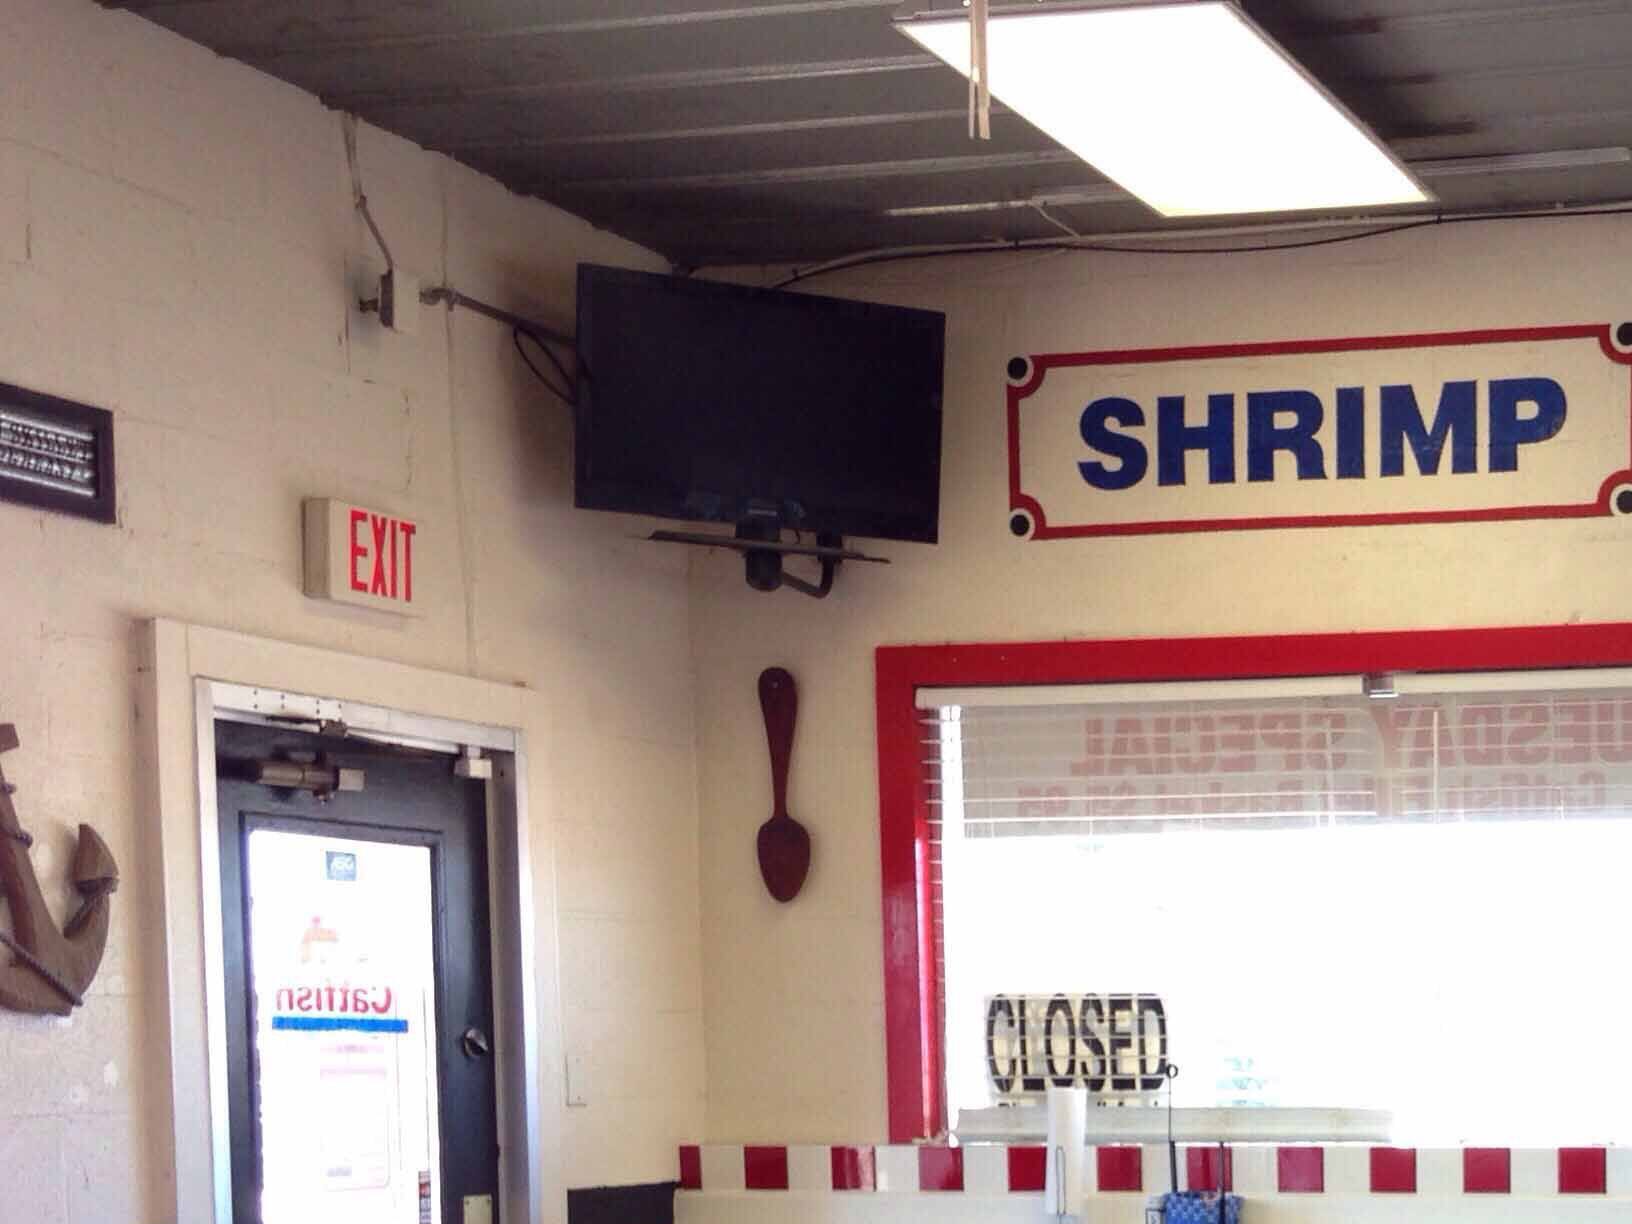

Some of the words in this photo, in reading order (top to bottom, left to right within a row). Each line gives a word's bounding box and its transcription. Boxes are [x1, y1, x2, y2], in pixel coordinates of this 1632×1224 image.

[1077, 376, 1568, 491] SHRIMP
[349, 508, 417, 603] EXIT
[987, 992, 1168, 1093] CLOSED
